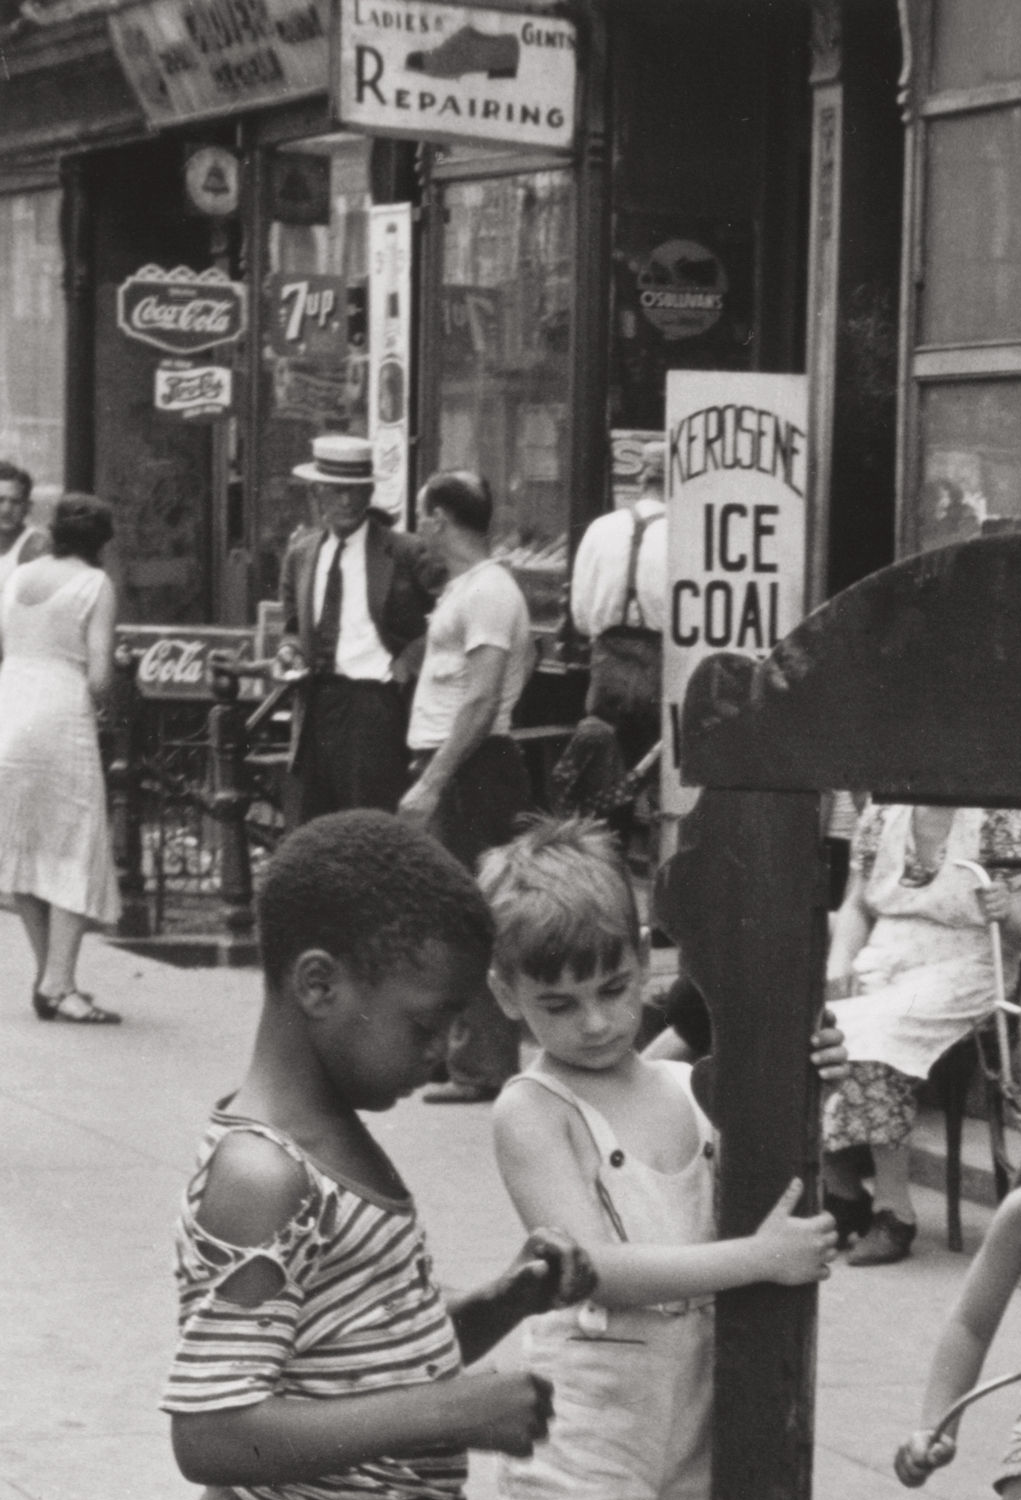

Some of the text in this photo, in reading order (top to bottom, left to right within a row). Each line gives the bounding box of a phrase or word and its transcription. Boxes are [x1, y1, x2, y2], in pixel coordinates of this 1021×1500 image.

[355, 44, 565, 128] REPAIRING
[669, 404, 806, 499] KEROSENE
[704, 503, 779, 573] ICE
[672, 579, 782, 648] COAL
